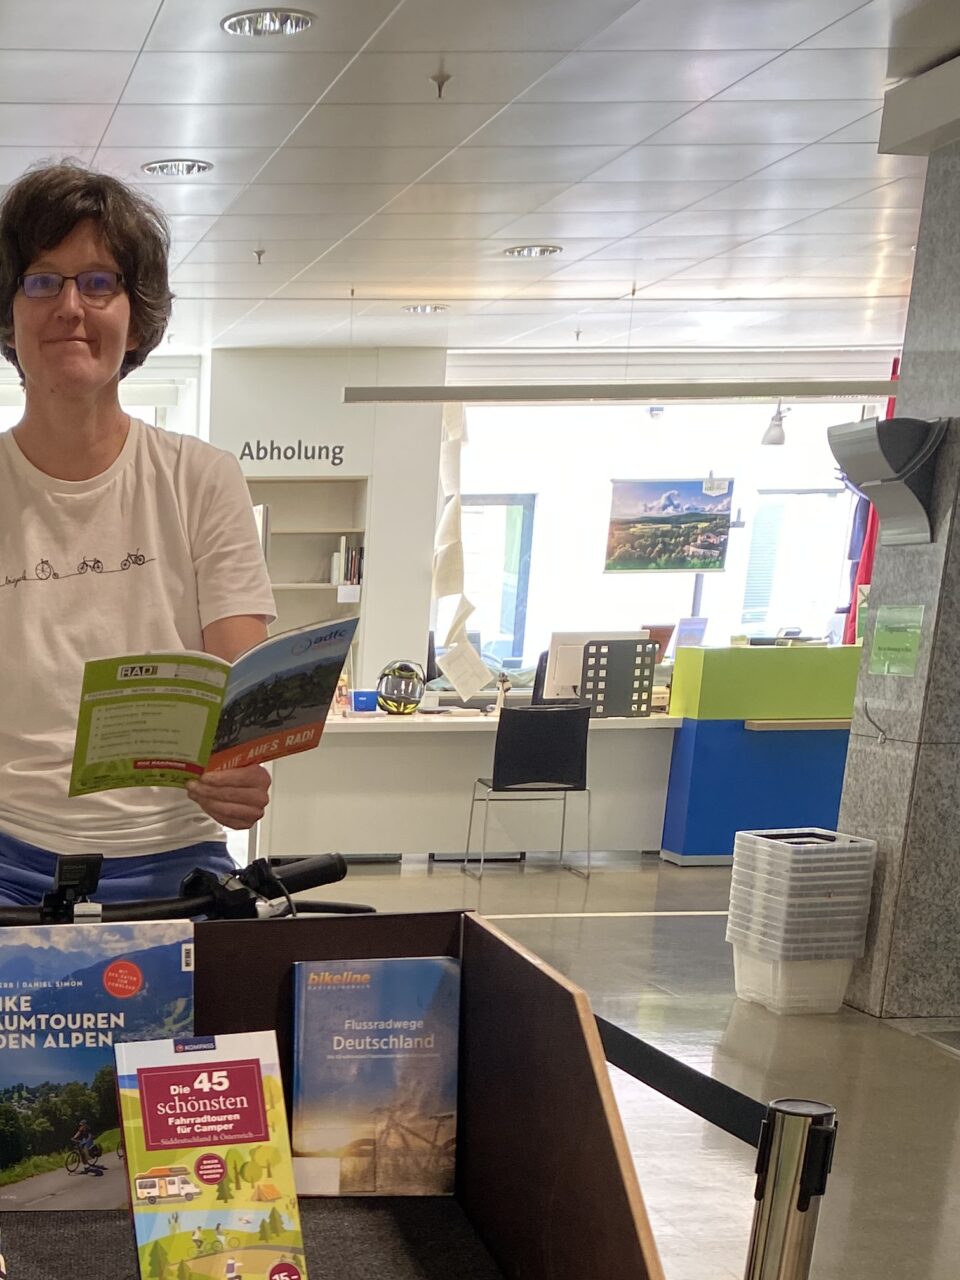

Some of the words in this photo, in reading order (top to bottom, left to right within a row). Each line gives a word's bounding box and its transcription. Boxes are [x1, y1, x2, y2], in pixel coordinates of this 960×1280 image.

[239, 440, 344, 466] Abholung
[22, 981, 52, 989] DANIEL
[55, 980, 83, 988] SIMON
[308, 971, 371, 985] bikeline
[345, 1019, 424, 1031] Flussradwege
[43, 1031, 113, 1049] ALPEN
[333, 1034, 435, 1051] Deutschland
[170, 1085, 191, 1095] Die
[193, 1071, 230, 1092] 45
[156, 1095, 248, 1115] schönsten
[168, 1113, 240, 1126] Fahrradtouren
[176, 1126, 192, 1134] für
[194, 1123, 234, 1134] Camper
